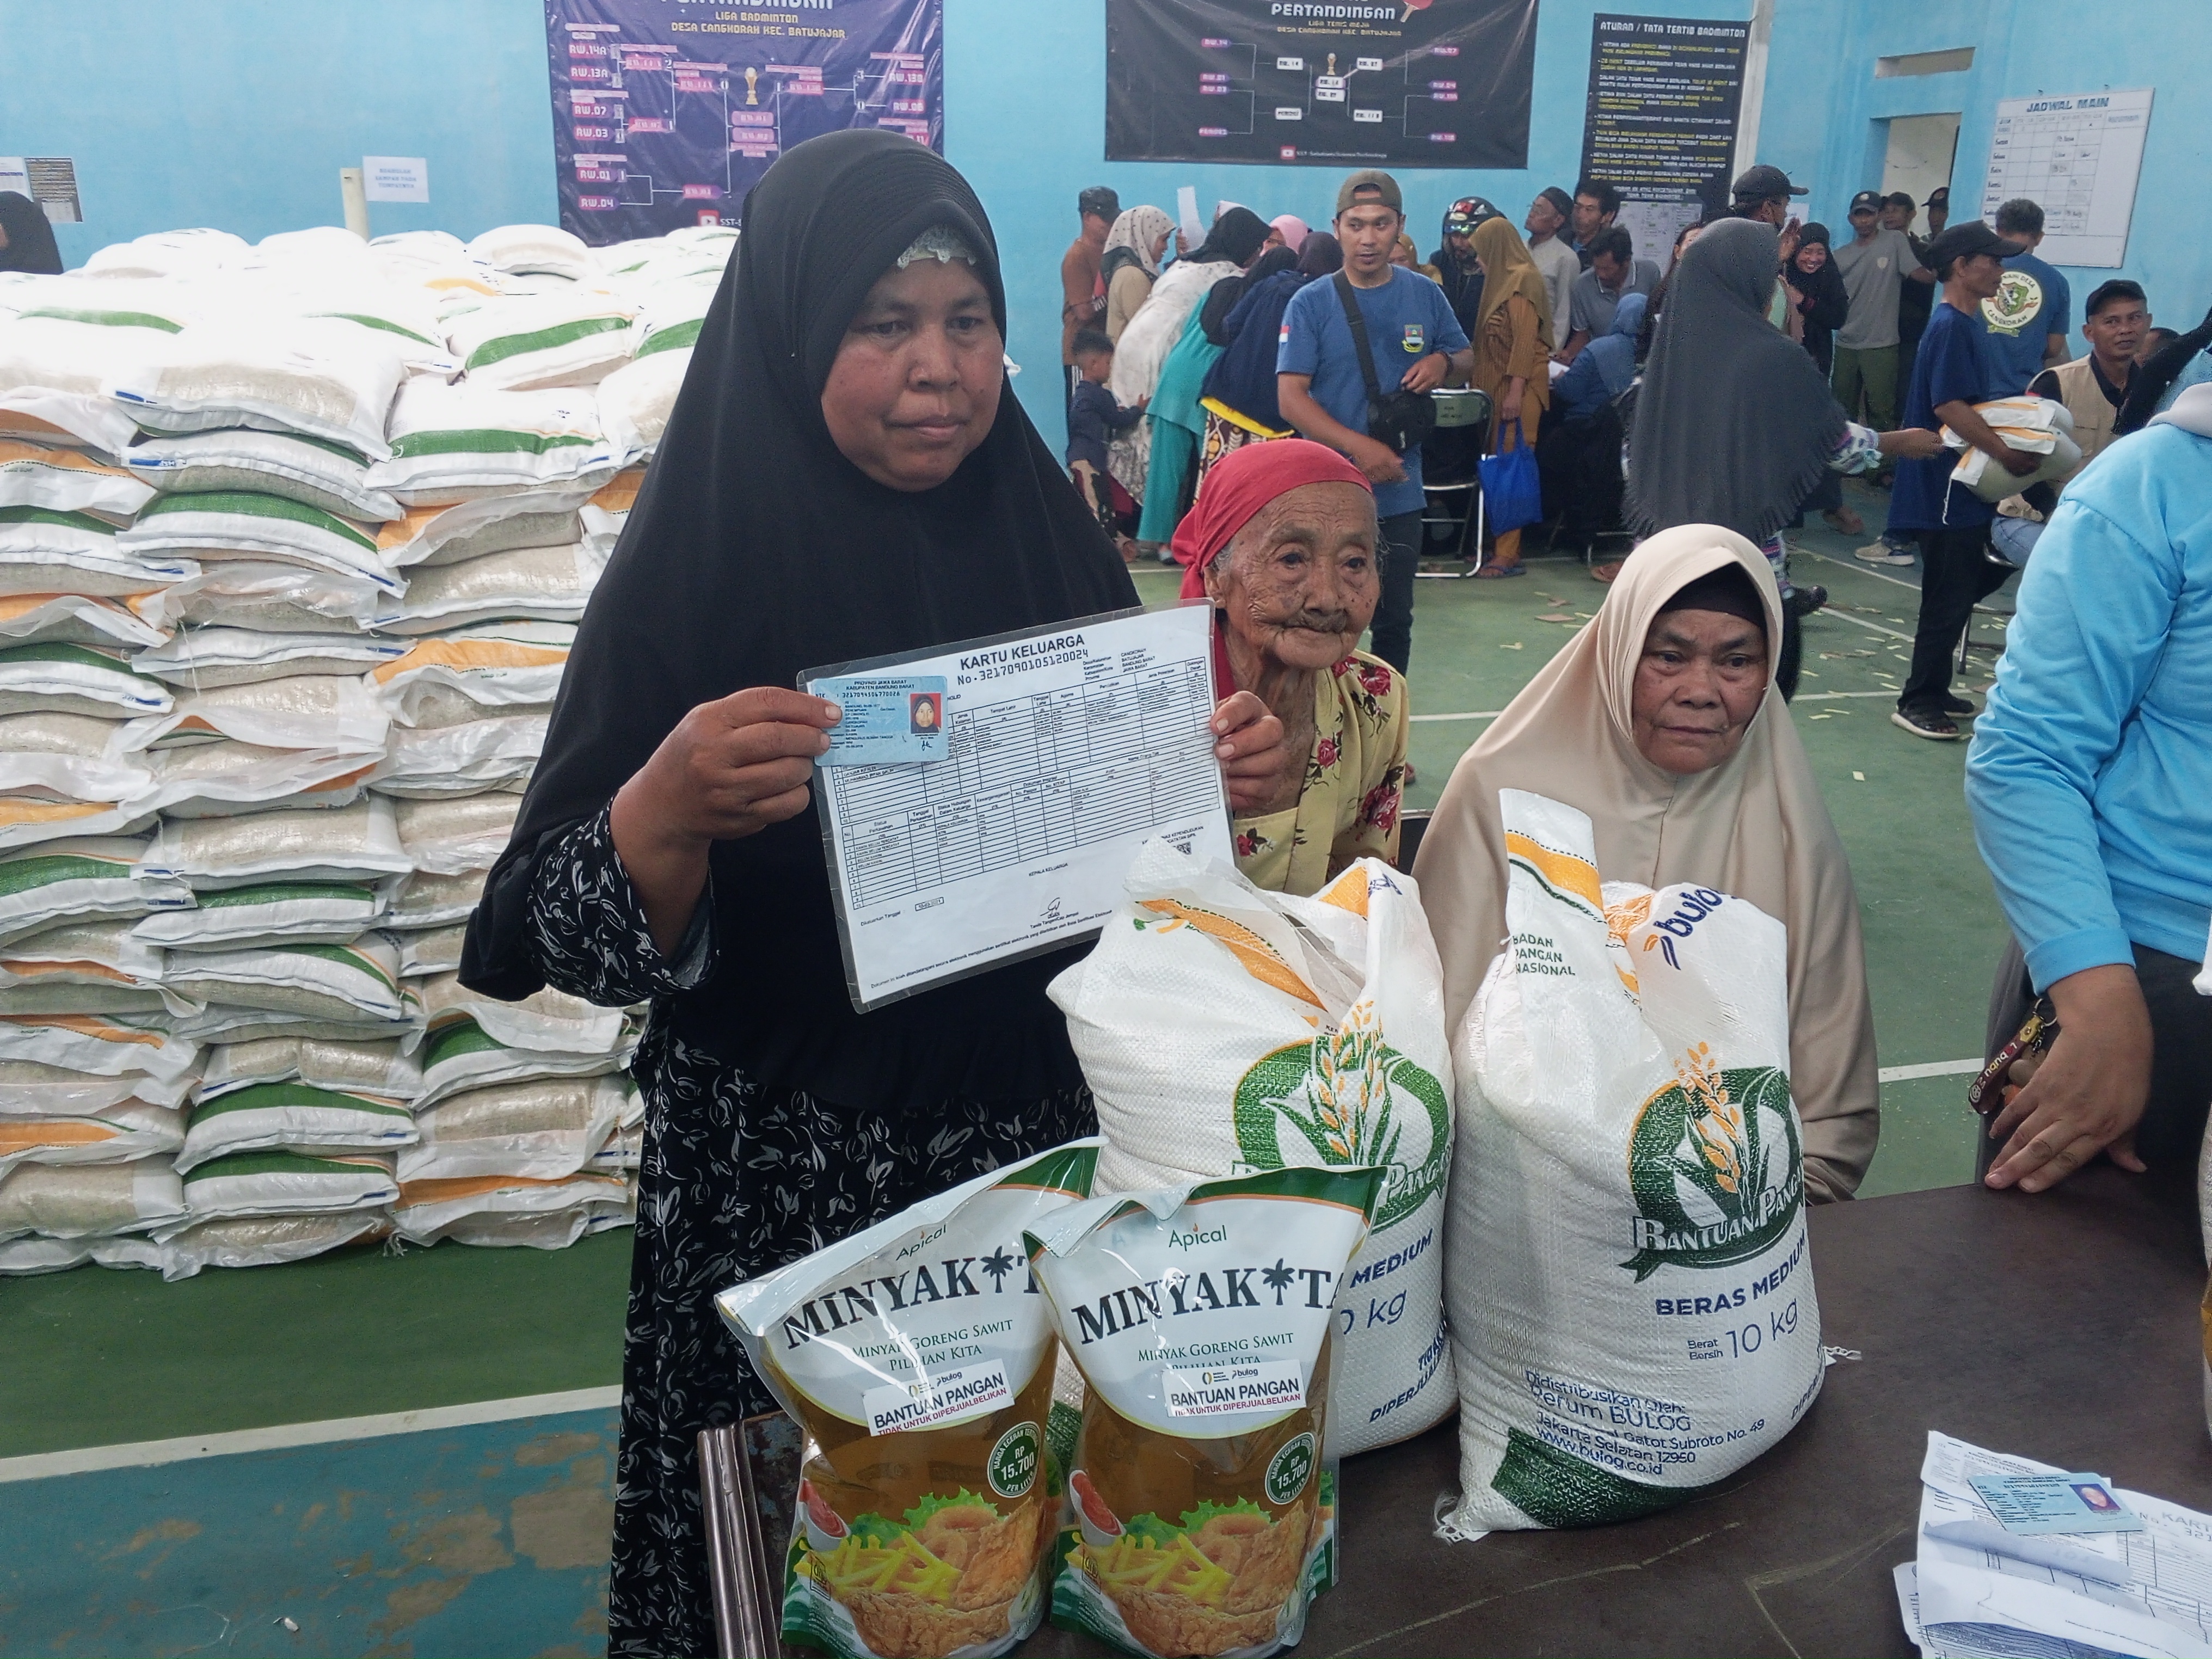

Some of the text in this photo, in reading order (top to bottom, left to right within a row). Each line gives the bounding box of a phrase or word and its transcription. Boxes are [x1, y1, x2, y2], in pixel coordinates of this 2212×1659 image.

[715, 11, 798, 23] LIGA BADMINTON
[1271, 3, 1396, 20] PERTANDINGAN
[671, 22, 698, 32] DESA
[789, 27, 845, 38] BATUJAJAR
[1600, 22, 1634, 31] ATURAN
[1643, 23, 1663, 33] TATA
[1667, 24, 1695, 35] TERTIB
[1697, 26, 1746, 38] BADMINTON
[569, 45, 607, 55] RW.14A
[571, 68, 608, 78] RW.13A
[665, 59, 672, 69] 2
[574, 106, 607, 115] RW.07
[2026, 97, 2110, 113] JADWAL MAIN
[576, 128, 609, 137] RW.03
[580, 170, 611, 180] RW.01
[581, 198, 613, 207] RW.04
[960, 634, 1085, 671] KARTU KELUARGA
[1654, 888, 1726, 937] bulo
[1513, 933, 1553, 948] BADAN
[1515, 962, 1576, 976] NASIONAL
[896, 1225, 947, 1261] Apical
[1168, 1224, 1227, 1252] Apical
[1633, 1215, 1754, 1252] BANTUAN
[1350, 1228, 1433, 1289] MEDIUM
[1656, 1228, 1805, 1316] BERAS MEDIUM
[1367, 1289, 1407, 1329] kg
[973, 1319, 1013, 1338] SAWIT
[1725, 1298, 1798, 1359] 10 kg
[951, 1344, 982, 1360] KITA
[1138, 1332, 1294, 1362] MINYAK GORENG SAWIT
[940, 1371, 962, 1384] bulog
[1237, 1368, 1258, 1377] bulog
[874, 1372, 1004, 1429] BANTUAN PANGAN
[1170, 1378, 1299, 1406] BANTUAN PANGAN
[903, 1414, 932, 1431] UNTUK
[932, 1387, 1007, 1421] DIPERJUALBELIKAN
[1196, 1404, 1221, 1415] UNTUK
[1222, 1393, 1301, 1412] DIPERJUALBELIKAN
[1609, 1405, 1691, 1431] BULOG
[1536, 1411, 1591, 1443] Jakarta
[1595, 1435, 1653, 1461] Selatan
[1656, 1451, 1696, 1463] 12950
[1669, 1433, 1724, 1450] Subroto
[1726, 1427, 1746, 1442] No.
[1749, 1418, 1766, 1433] 49
[1015, 1446, 1025, 1459] RP
[1536, 1427, 1662, 1475] www.bulog.co.id
[1001, 1452, 1034, 1480] 15.700
[1291, 1455, 1300, 1468] RP
[1277, 1460, 1307, 1489] 15.700
[1006, 1484, 1019, 1492] PER
[2162, 1511, 2212, 1532] KART
